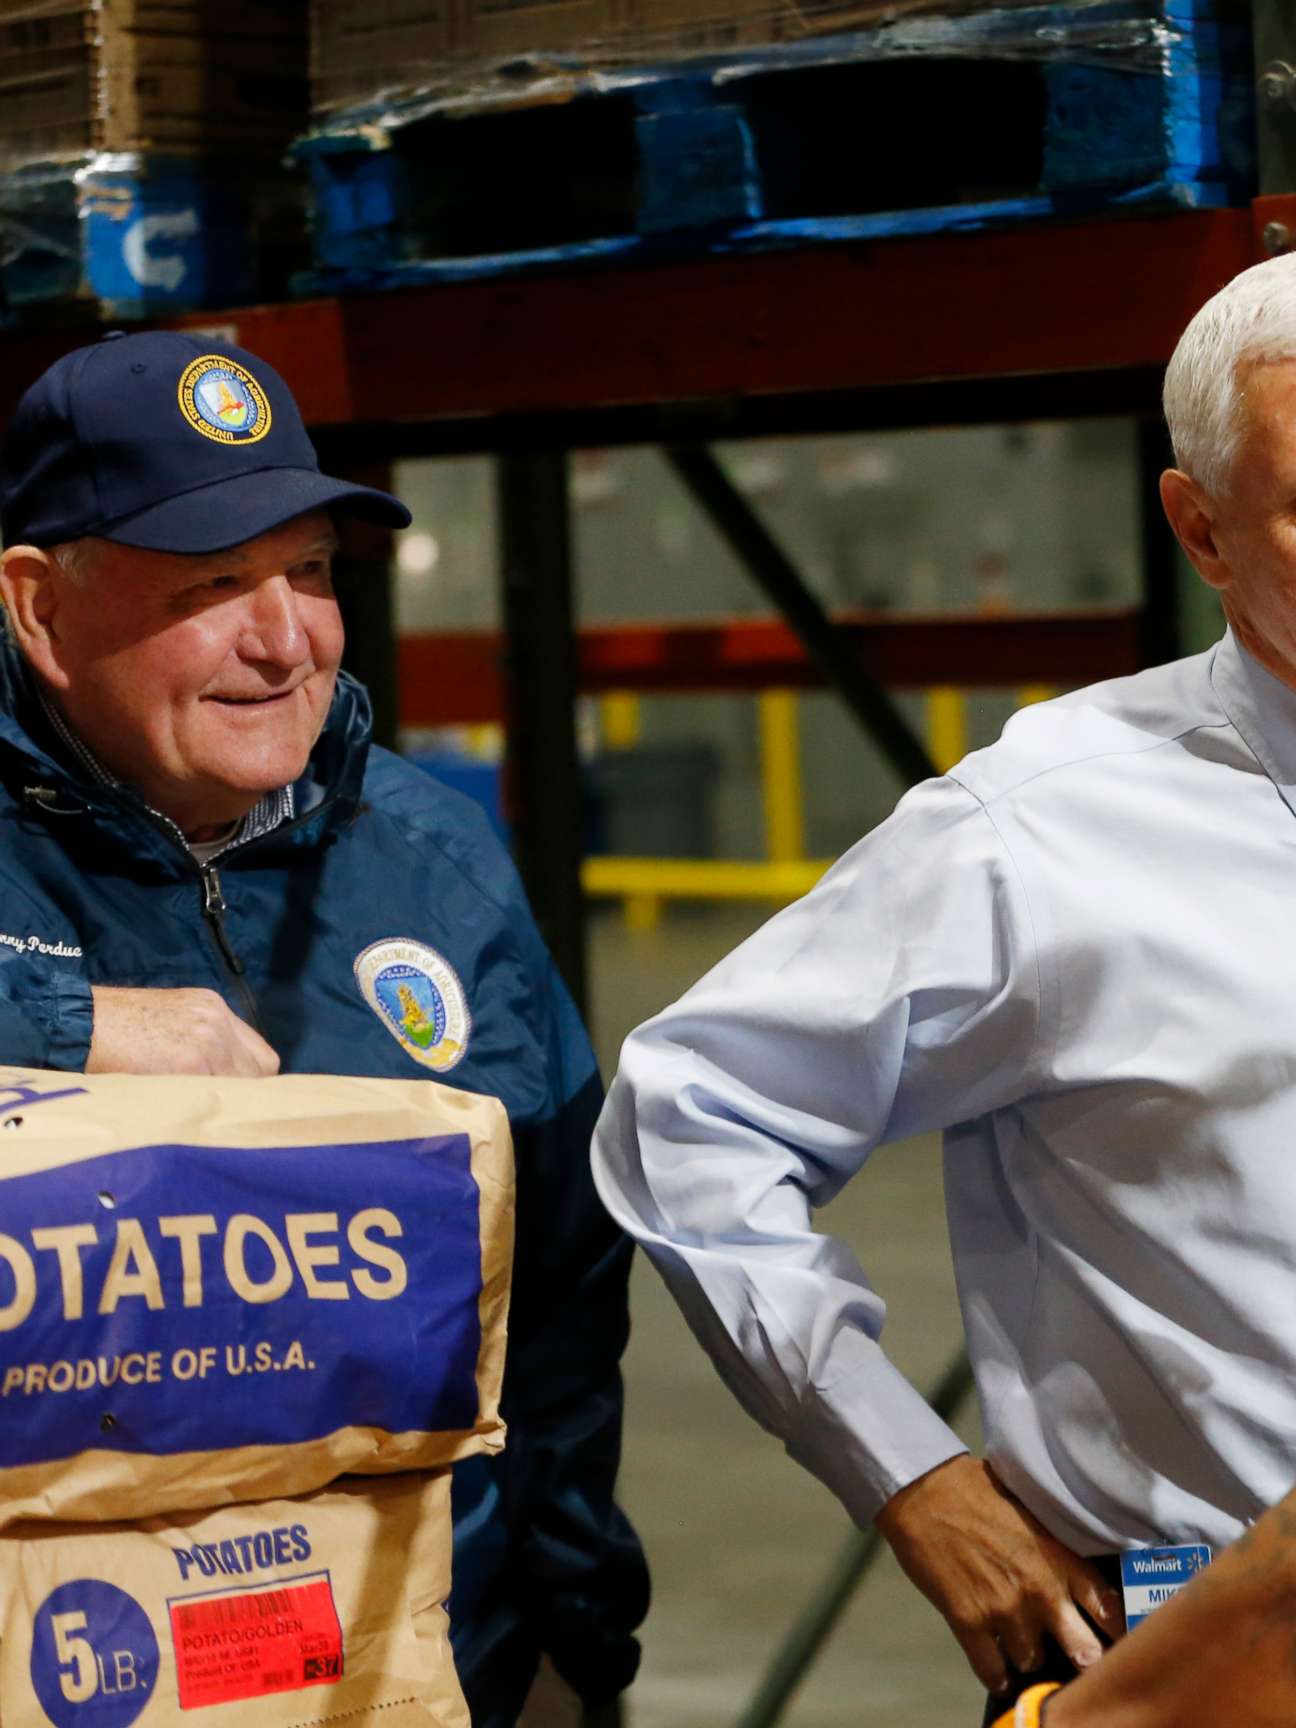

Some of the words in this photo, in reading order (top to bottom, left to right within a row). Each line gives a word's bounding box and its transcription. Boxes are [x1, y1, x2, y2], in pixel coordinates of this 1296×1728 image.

[28, 936, 82, 957] Perdue
[2, 1351, 162, 1396] PRODUCE
[171, 1346, 217, 1380] OF
[225, 1340, 316, 1376] U.S.A.
[171, 1523, 312, 1581] POTATOES
[1133, 1557, 1182, 1573] Walmart
[51, 1609, 99, 1704] 5
